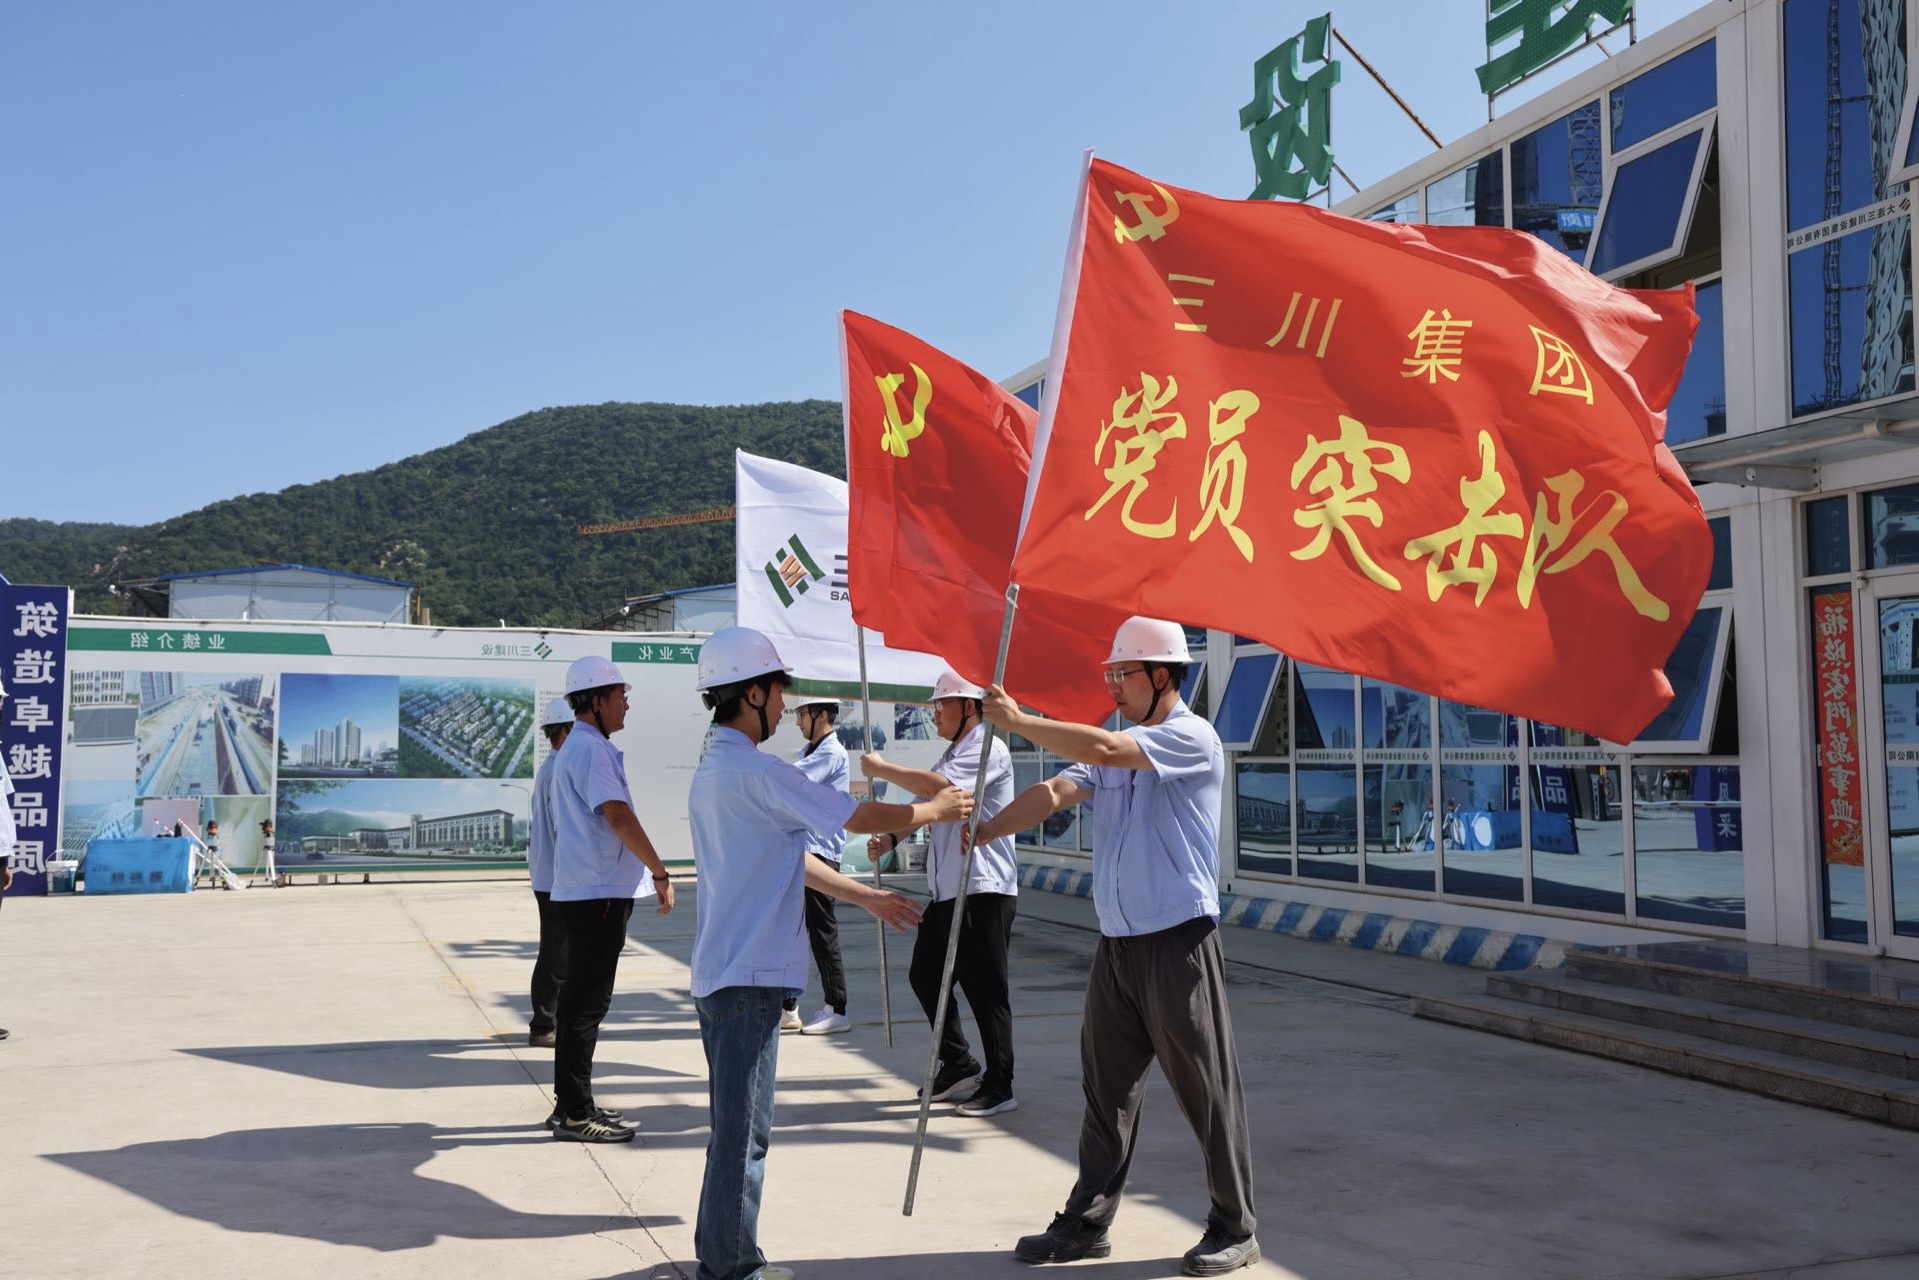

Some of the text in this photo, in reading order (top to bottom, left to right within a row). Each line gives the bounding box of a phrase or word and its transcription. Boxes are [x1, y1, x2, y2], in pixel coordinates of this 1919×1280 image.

[1167, 272, 1594, 405] 三川集团
[1084, 370, 1670, 622] 党员突击队
